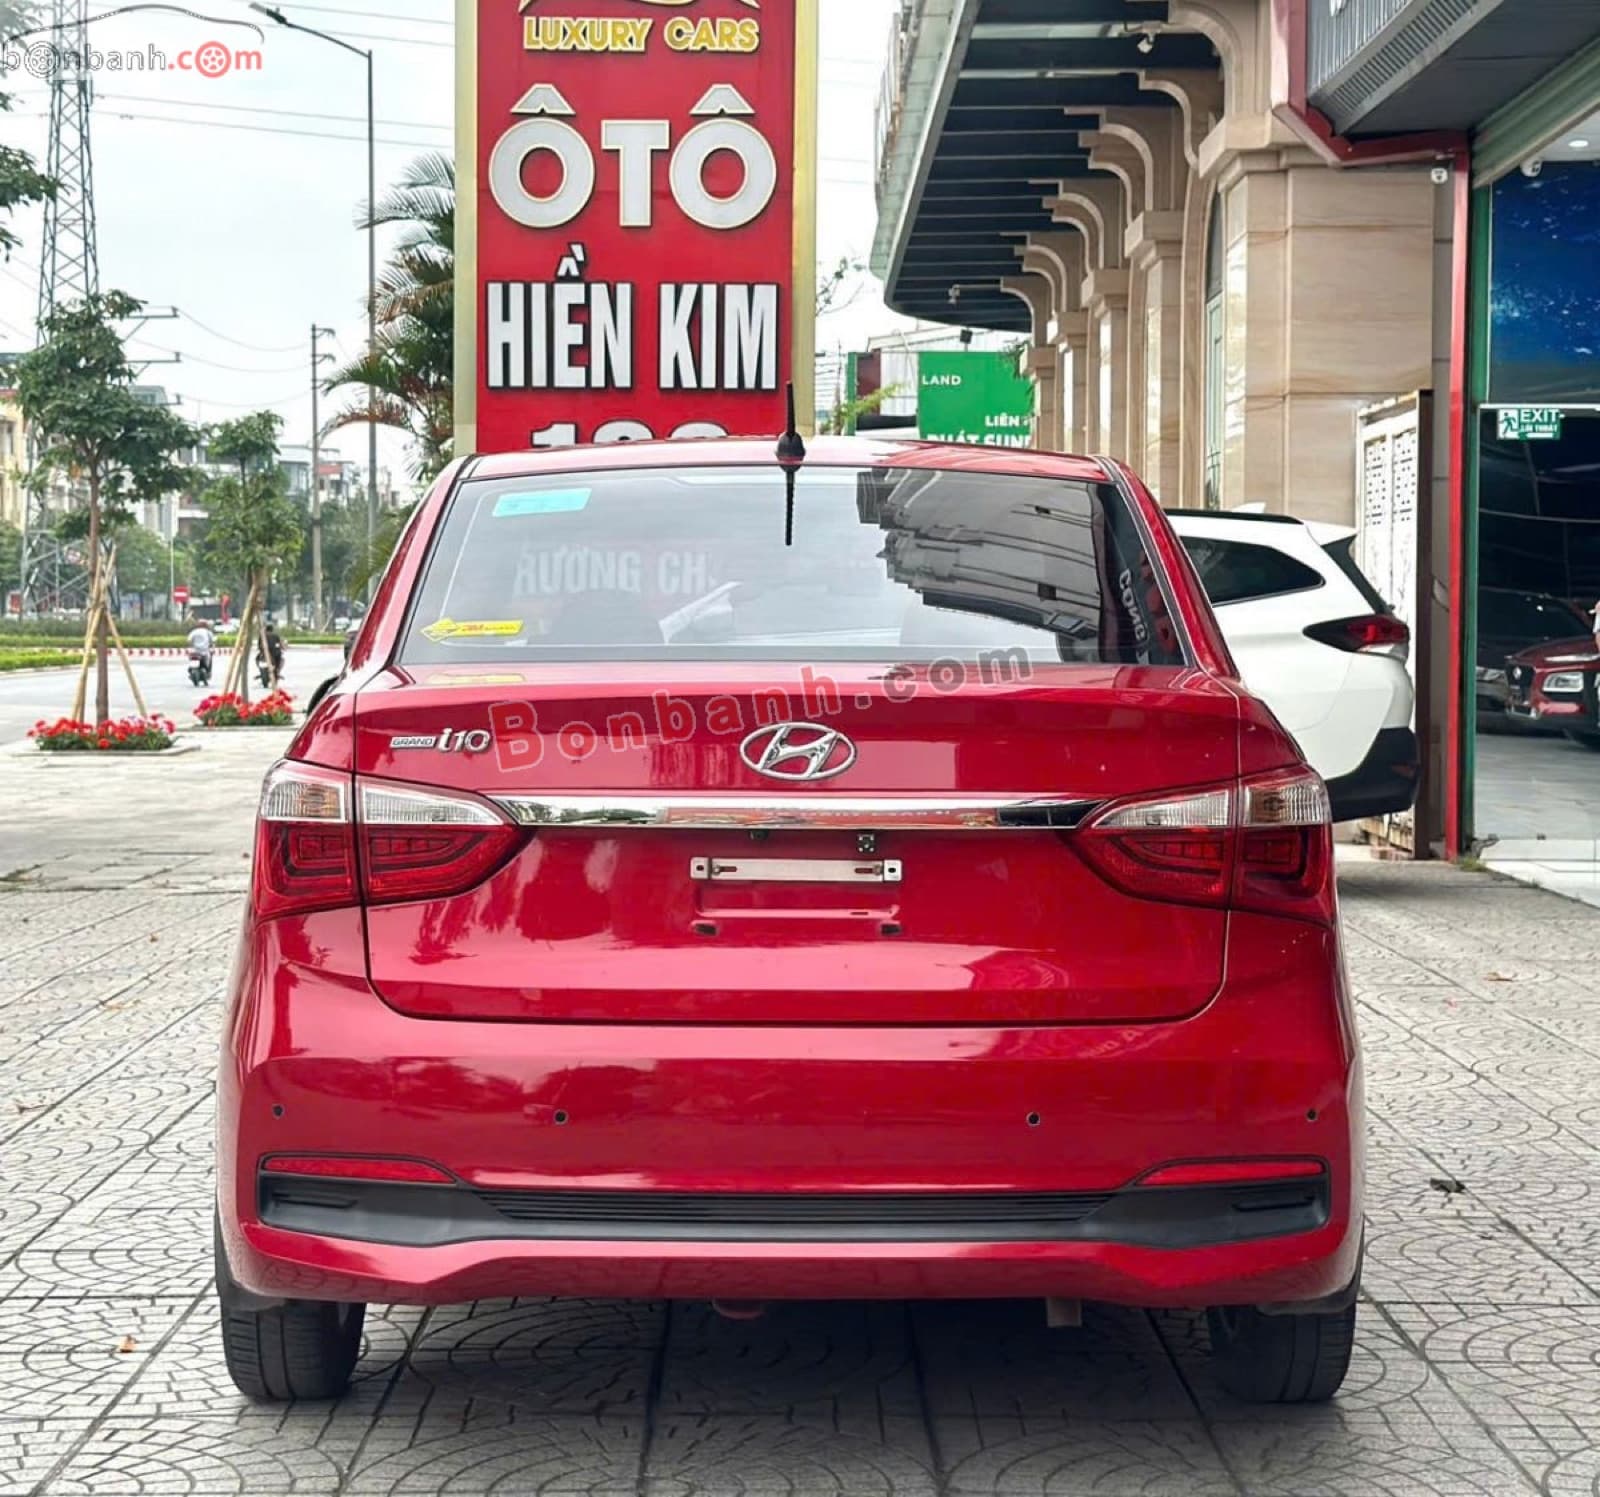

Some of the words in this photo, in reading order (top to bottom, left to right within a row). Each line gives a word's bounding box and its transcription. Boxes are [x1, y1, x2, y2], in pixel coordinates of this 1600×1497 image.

[523, 16, 652, 52] LUXURY
[663, 16, 760, 53] CARS
[488, 83, 777, 229] ÔTÔ
[486, 242, 634, 391] HIỀN
[657, 282, 781, 391] KIM
[921, 374, 962, 387] LAND
[984, 411, 1020, 428] LIÊN
[1520, 408, 1559, 423] EXIT
[391, 737, 436, 749] GRAND
[438, 727, 491, 752] i10
